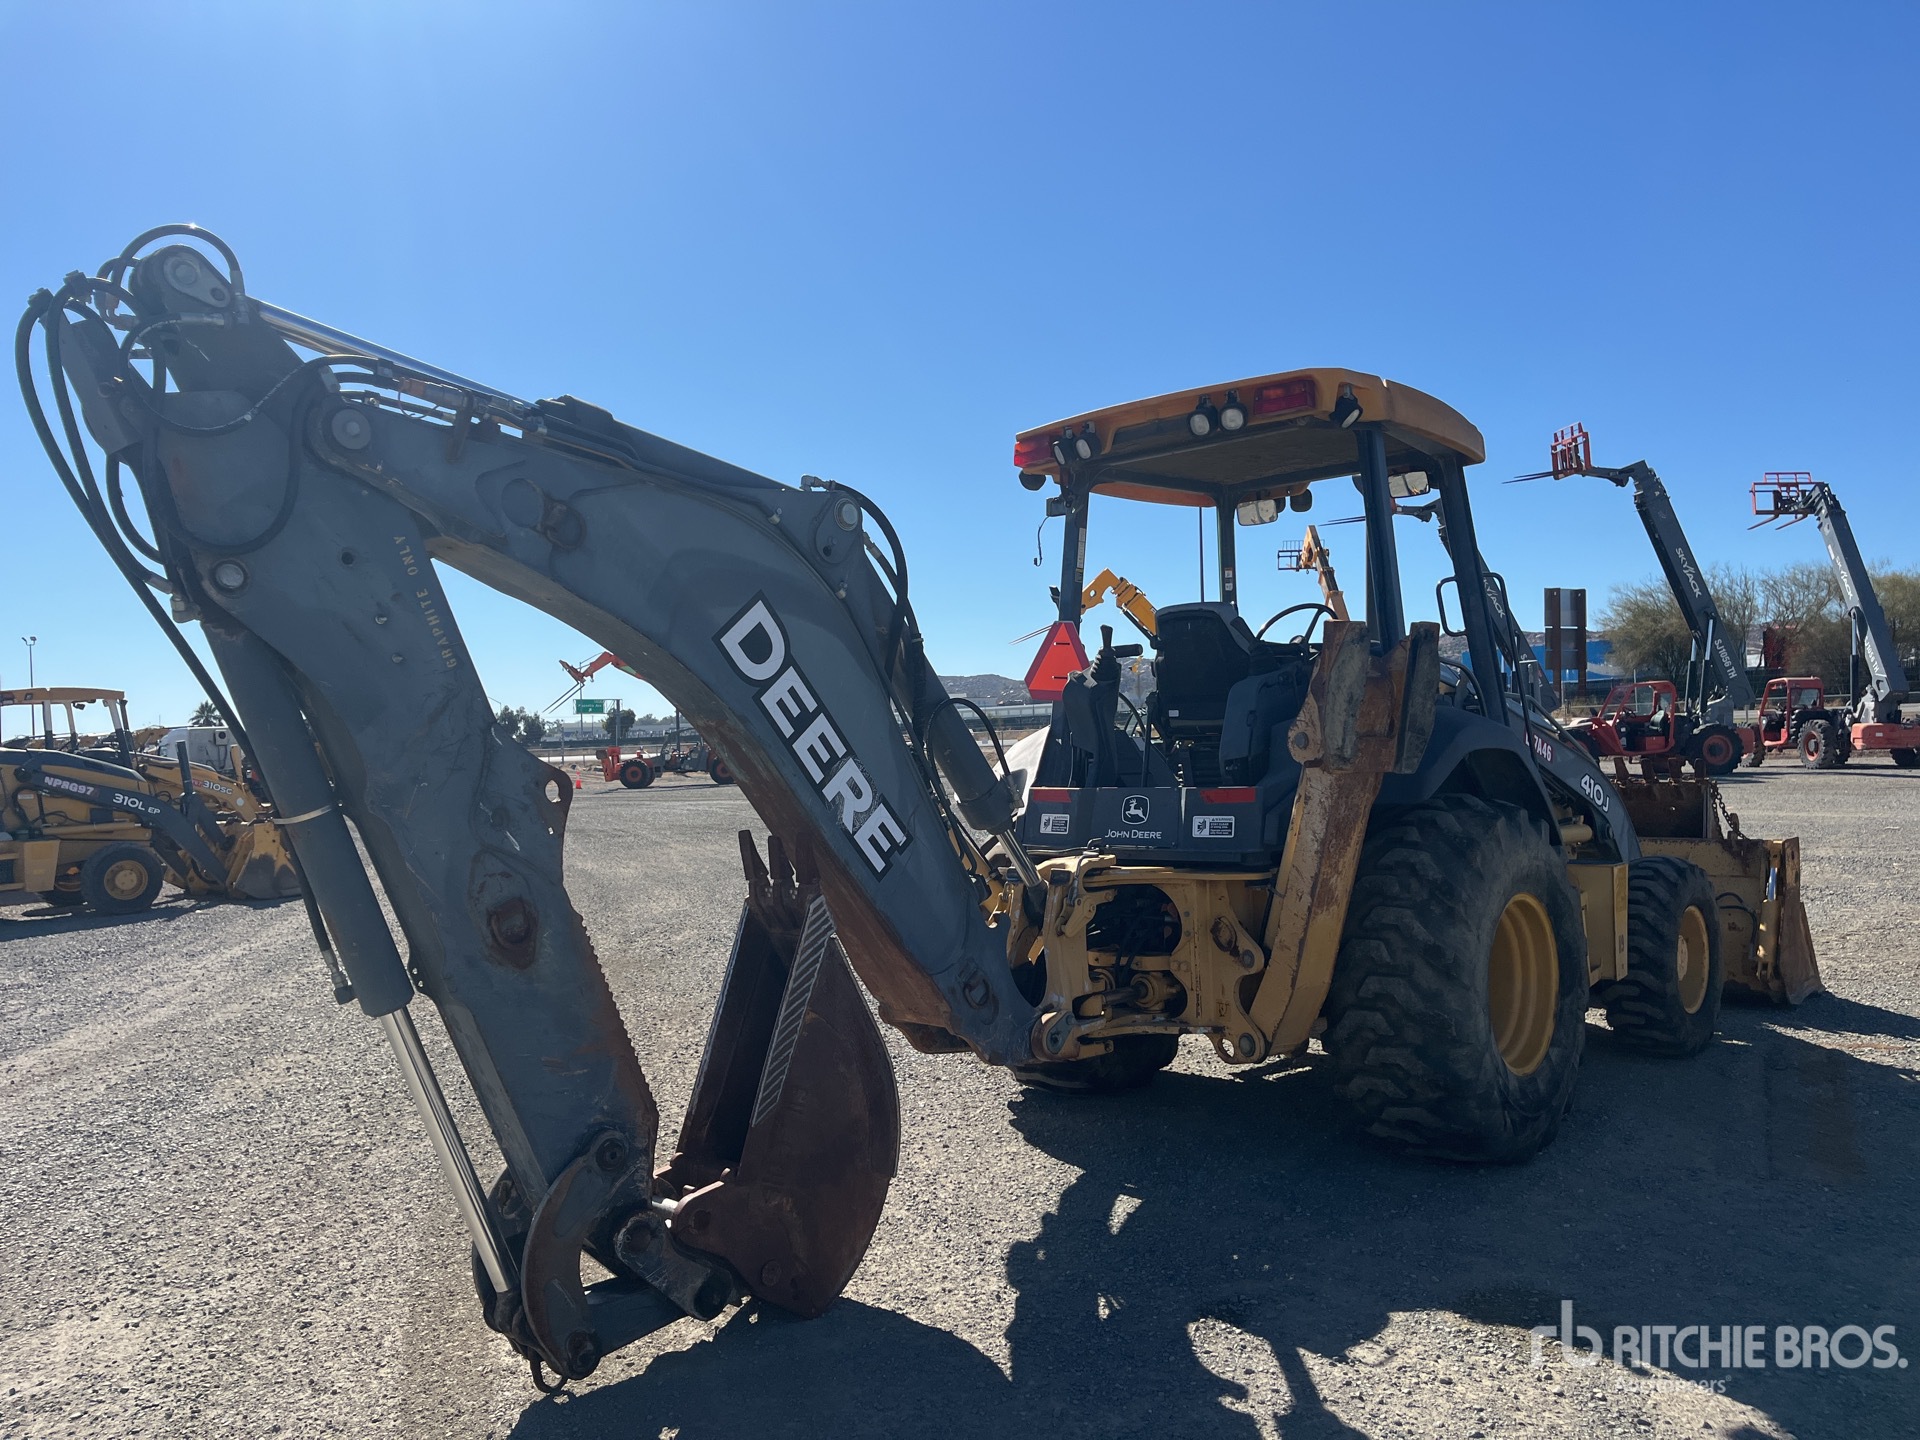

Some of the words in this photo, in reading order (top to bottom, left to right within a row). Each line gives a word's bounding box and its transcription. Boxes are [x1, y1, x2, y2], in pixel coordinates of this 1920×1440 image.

[393, 535, 419, 576] ONLY
[1676, 547, 1702, 598] SKYJACK
[1483, 576, 1506, 619] KYJACK
[416, 588, 457, 668] GRAPHITE
[1714, 639, 1732, 667] SJ1056
[1726, 666, 1738, 679] TH
[719, 600, 907, 873] DEERE
[112, 793, 146, 811] 310L
[147, 806, 161, 815] EP
[1581, 774, 1609, 812] 410J
[1104, 829, 1130, 839] JOHN
[1131, 829, 1163, 840] DEERE
